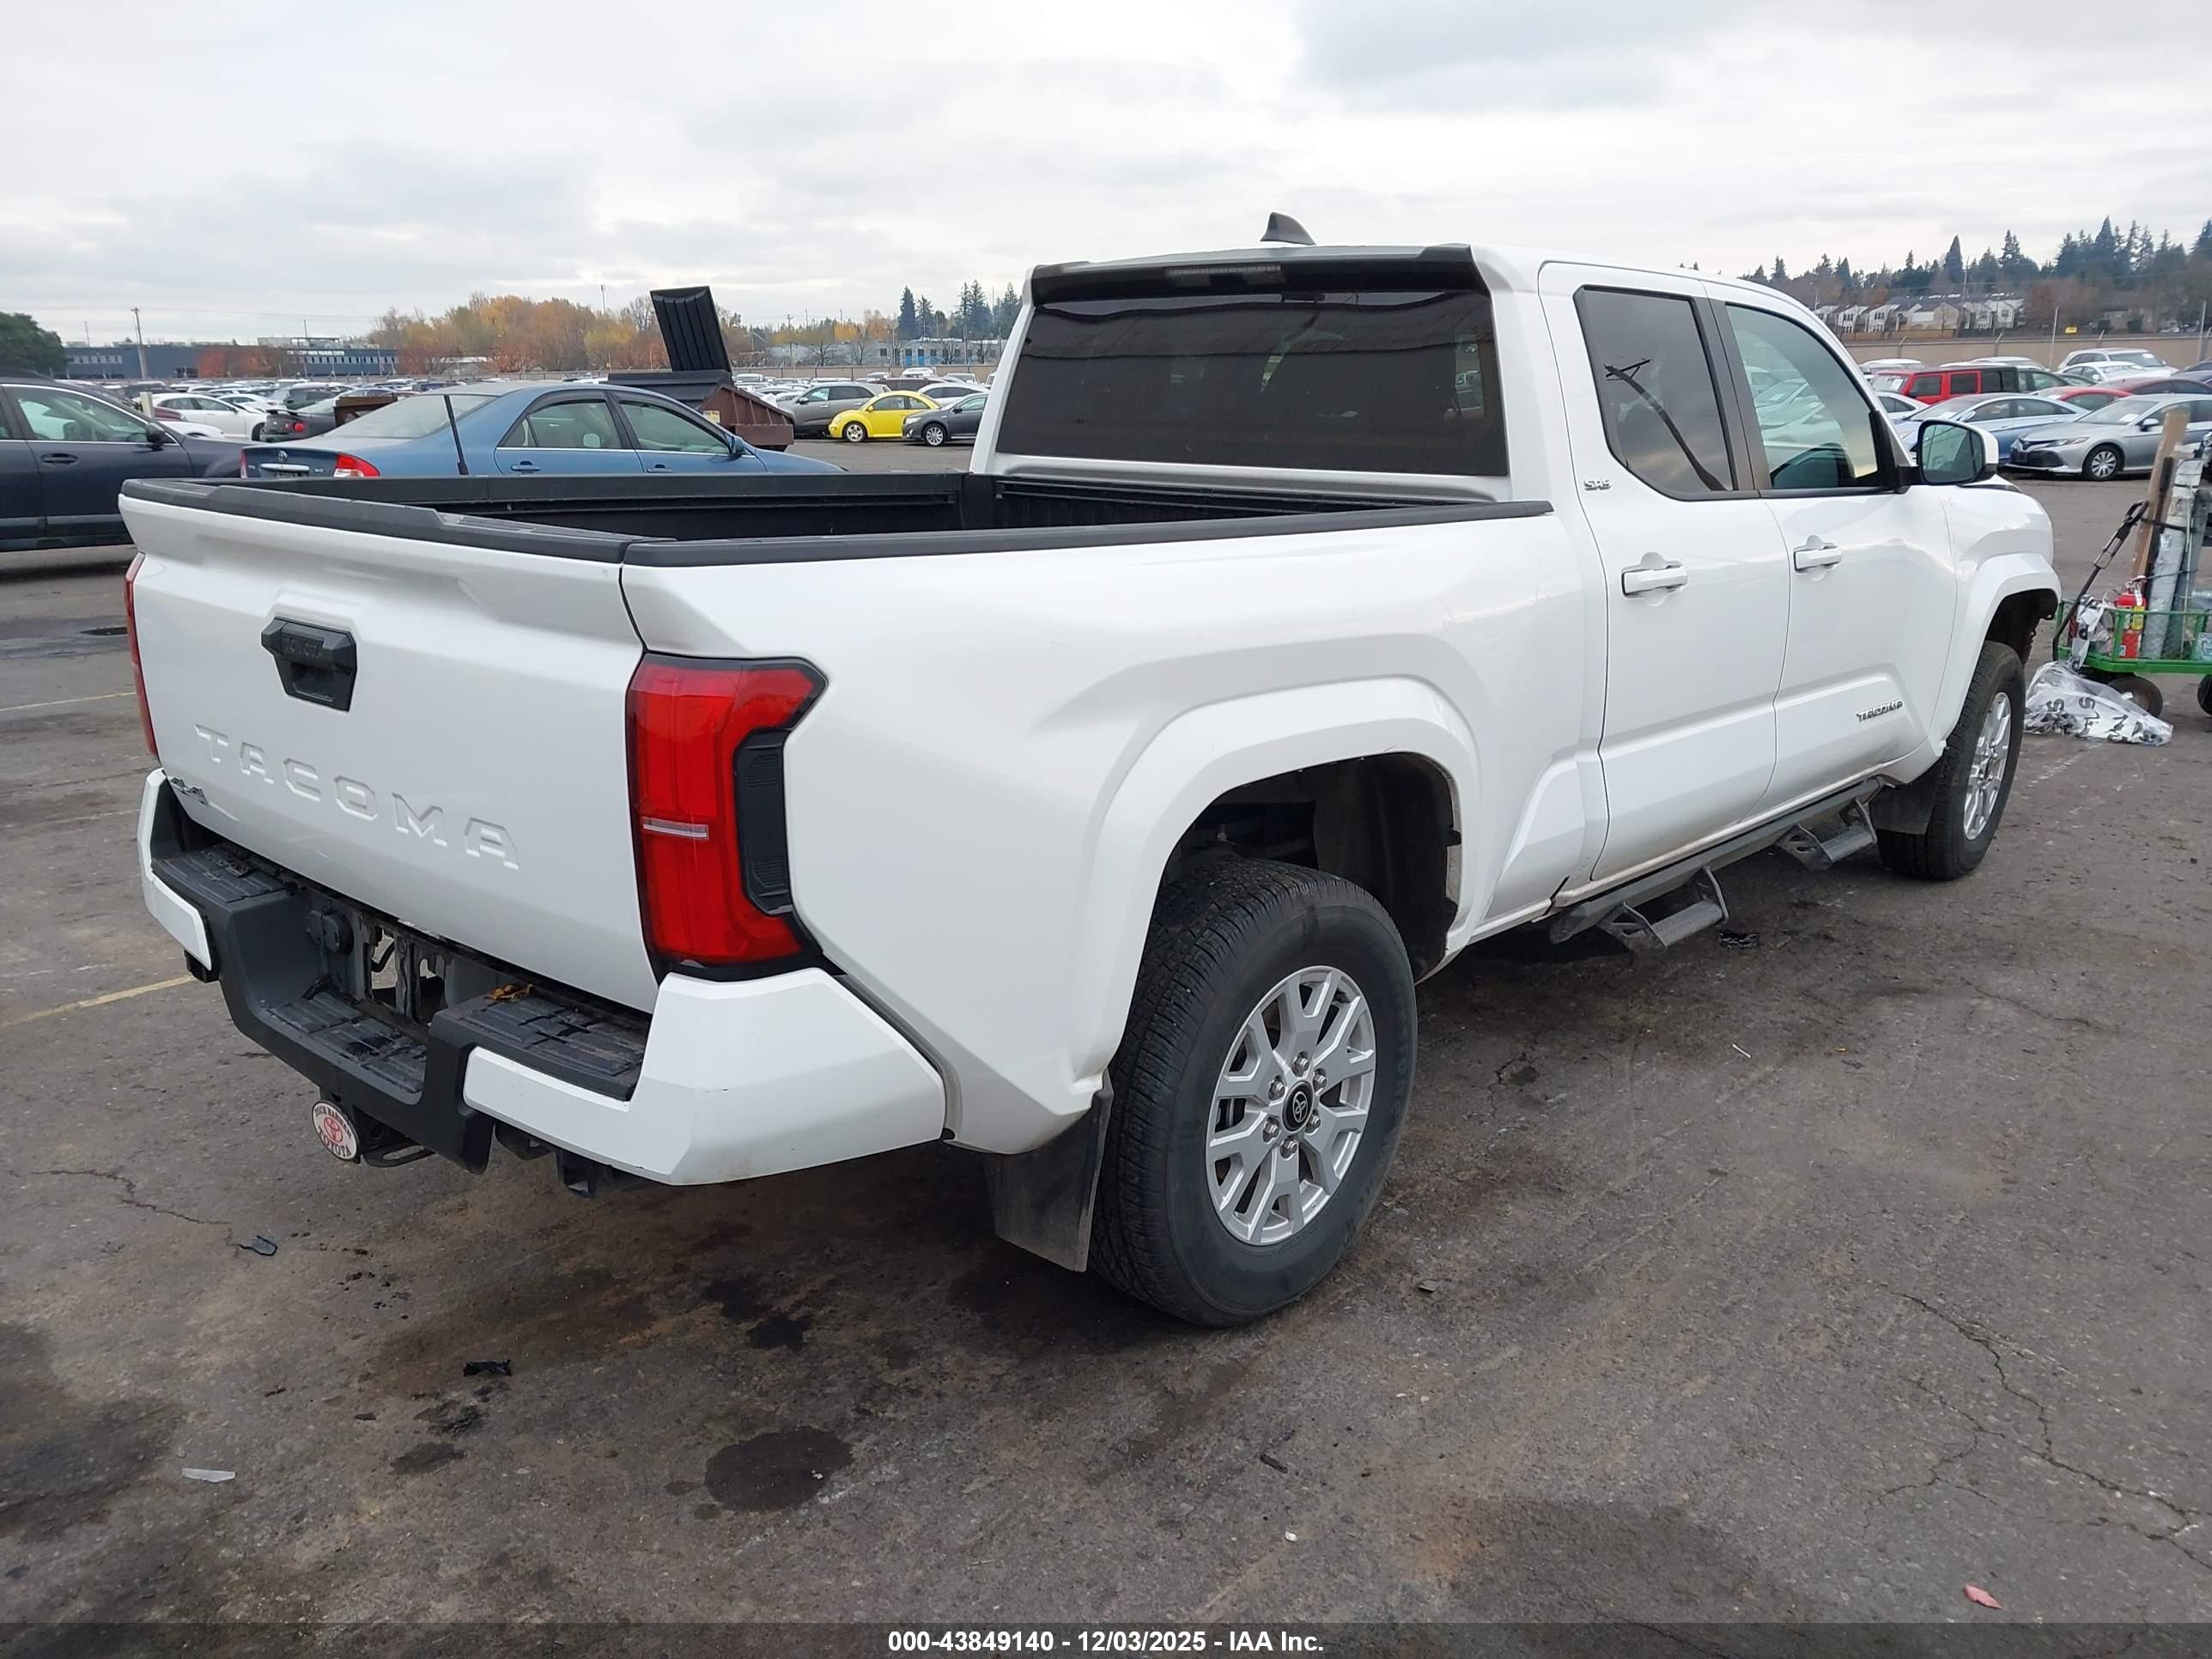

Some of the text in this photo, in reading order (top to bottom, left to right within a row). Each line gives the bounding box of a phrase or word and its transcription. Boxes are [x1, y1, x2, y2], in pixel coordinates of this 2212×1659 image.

[1856, 700, 1903, 722] TACOMA
[194, 723, 520, 870] TACOMA
[317, 1126, 352, 1158] TOYOTA
